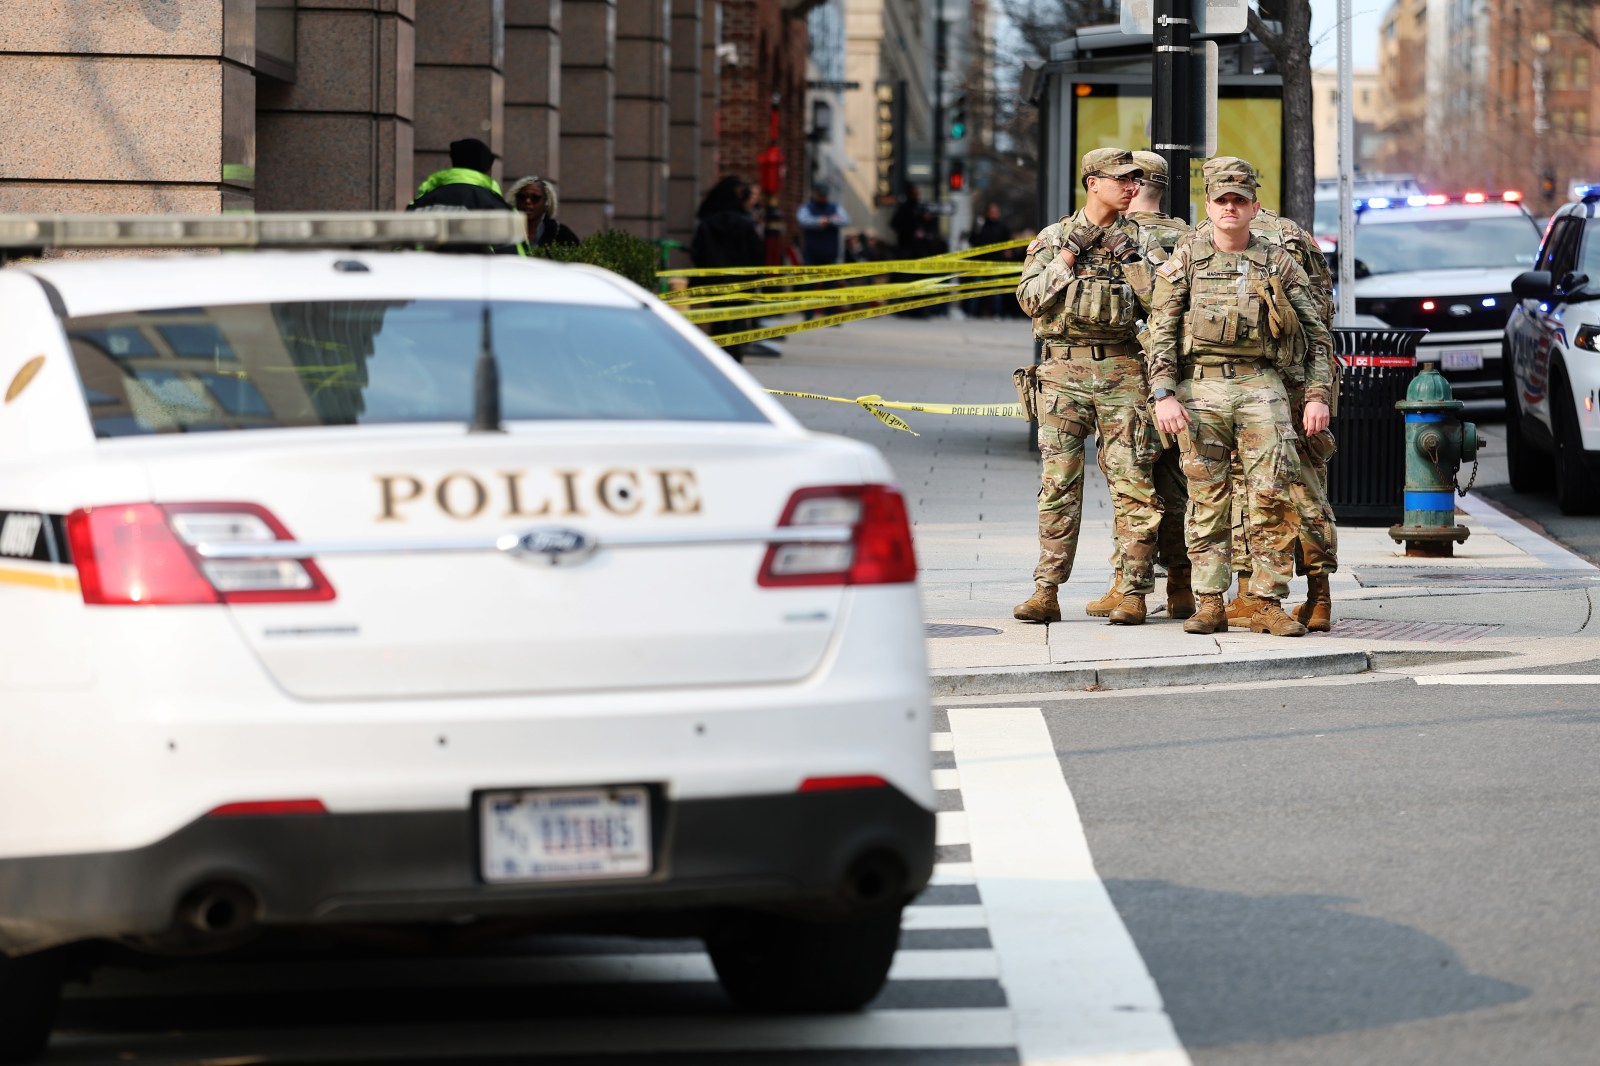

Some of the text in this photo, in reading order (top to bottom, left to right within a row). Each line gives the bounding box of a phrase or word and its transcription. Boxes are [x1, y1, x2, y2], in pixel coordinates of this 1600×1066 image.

[732, 335, 750, 344] POLICE
[750, 332, 761, 340] LINE
[771, 328, 781, 336] NOT
[782, 326, 798, 334] CROSS
[802, 320, 820, 330] POLICE
[820, 318, 832, 326] LINE
[852, 311, 868, 320] CROSS
[1356, 357, 1368, 366] DC
[952, 406, 980, 416] POLICE
[982, 406, 1000, 416] LINE
[1002, 406, 1013, 416] DO
[371, 465, 705, 523] POLICE
